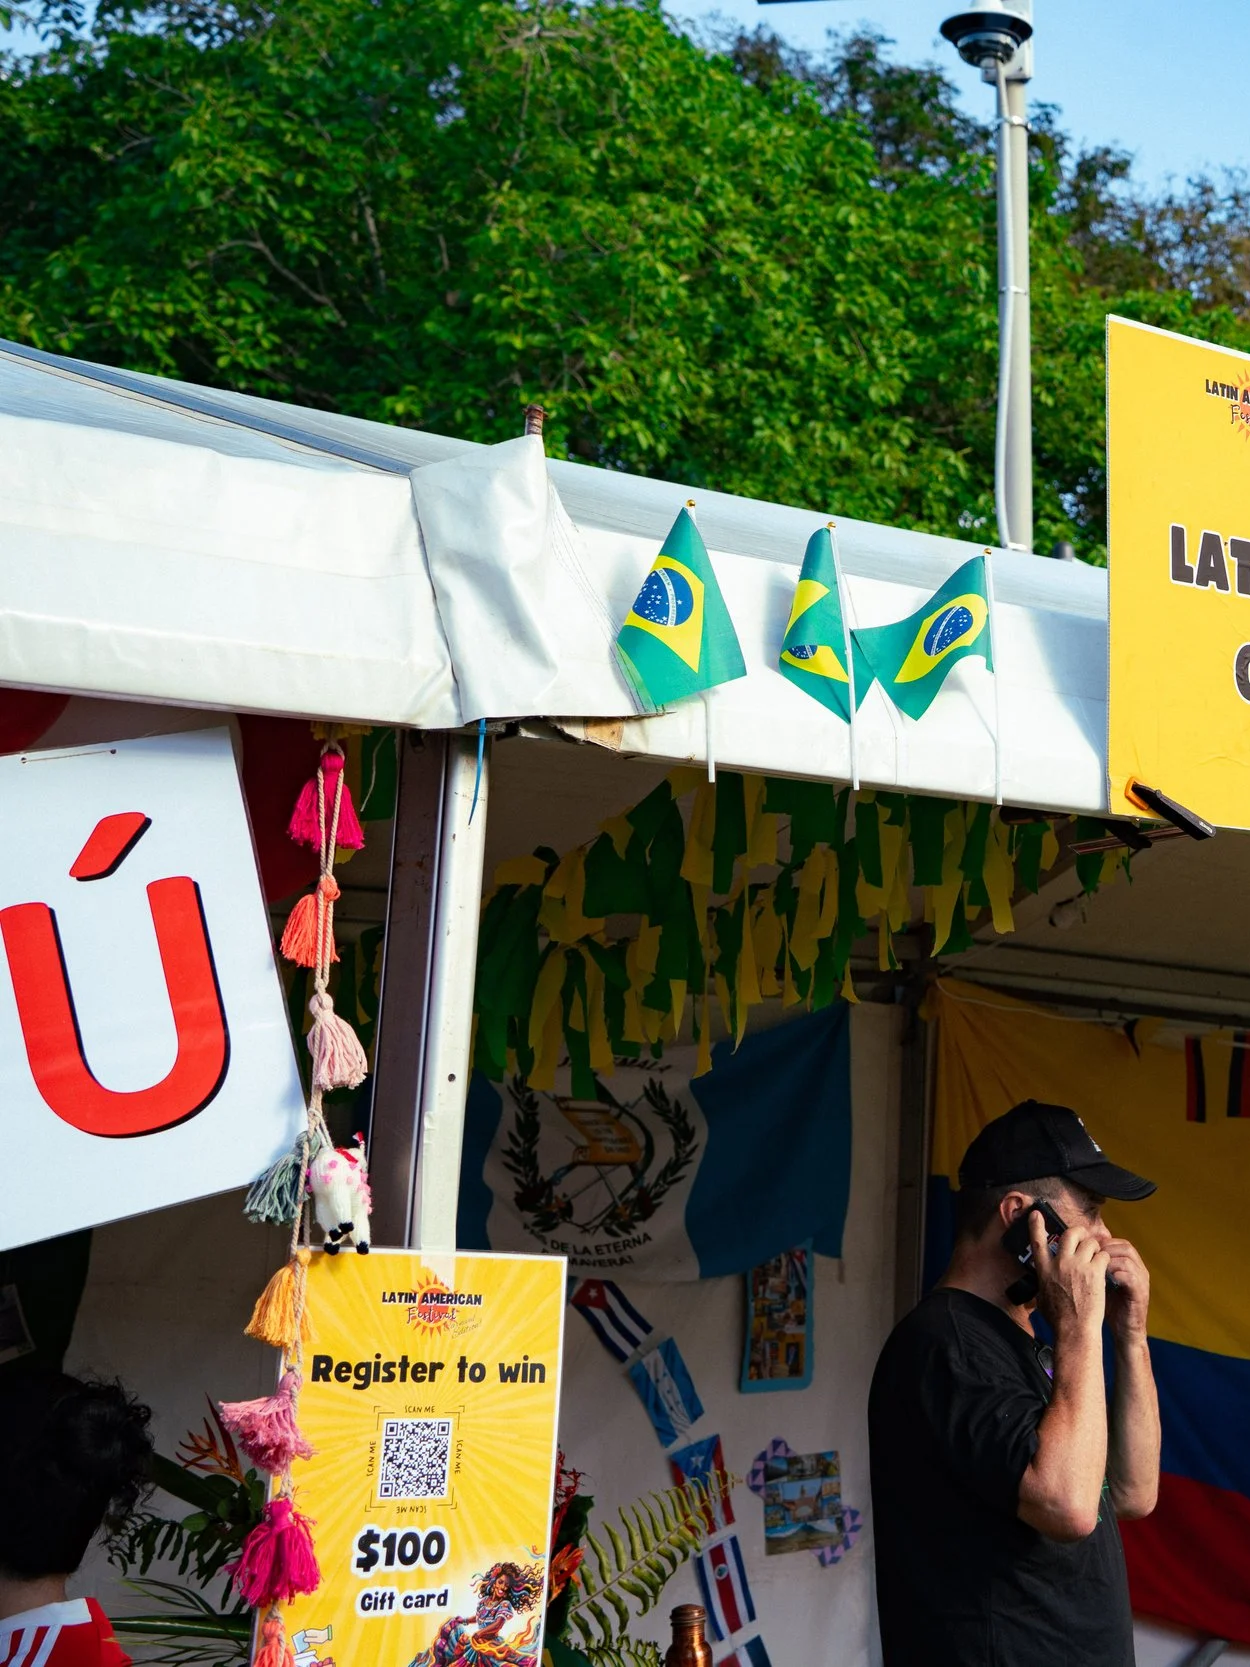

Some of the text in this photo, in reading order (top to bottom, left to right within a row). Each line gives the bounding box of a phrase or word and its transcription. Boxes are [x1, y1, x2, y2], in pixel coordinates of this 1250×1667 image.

[1205, 378, 1239, 401] LATIN
[0, 811, 231, 1138] Ú
[550, 1232, 653, 1256] DE LA ETERNA
[382, 1291, 483, 1306] LATIN AMERICAN
[407, 1306, 457, 1325] Festival
[311, 1353, 546, 1391] Register to win
[404, 1404, 436, 1414] SCAN ME
[366, 1440, 377, 1477] SCAN ME
[454, 1439, 464, 1475] SCAN ME
[396, 1505, 427, 1514] SCAN ME
[355, 1530, 448, 1573] $100
[360, 1588, 449, 1613] Gift card
